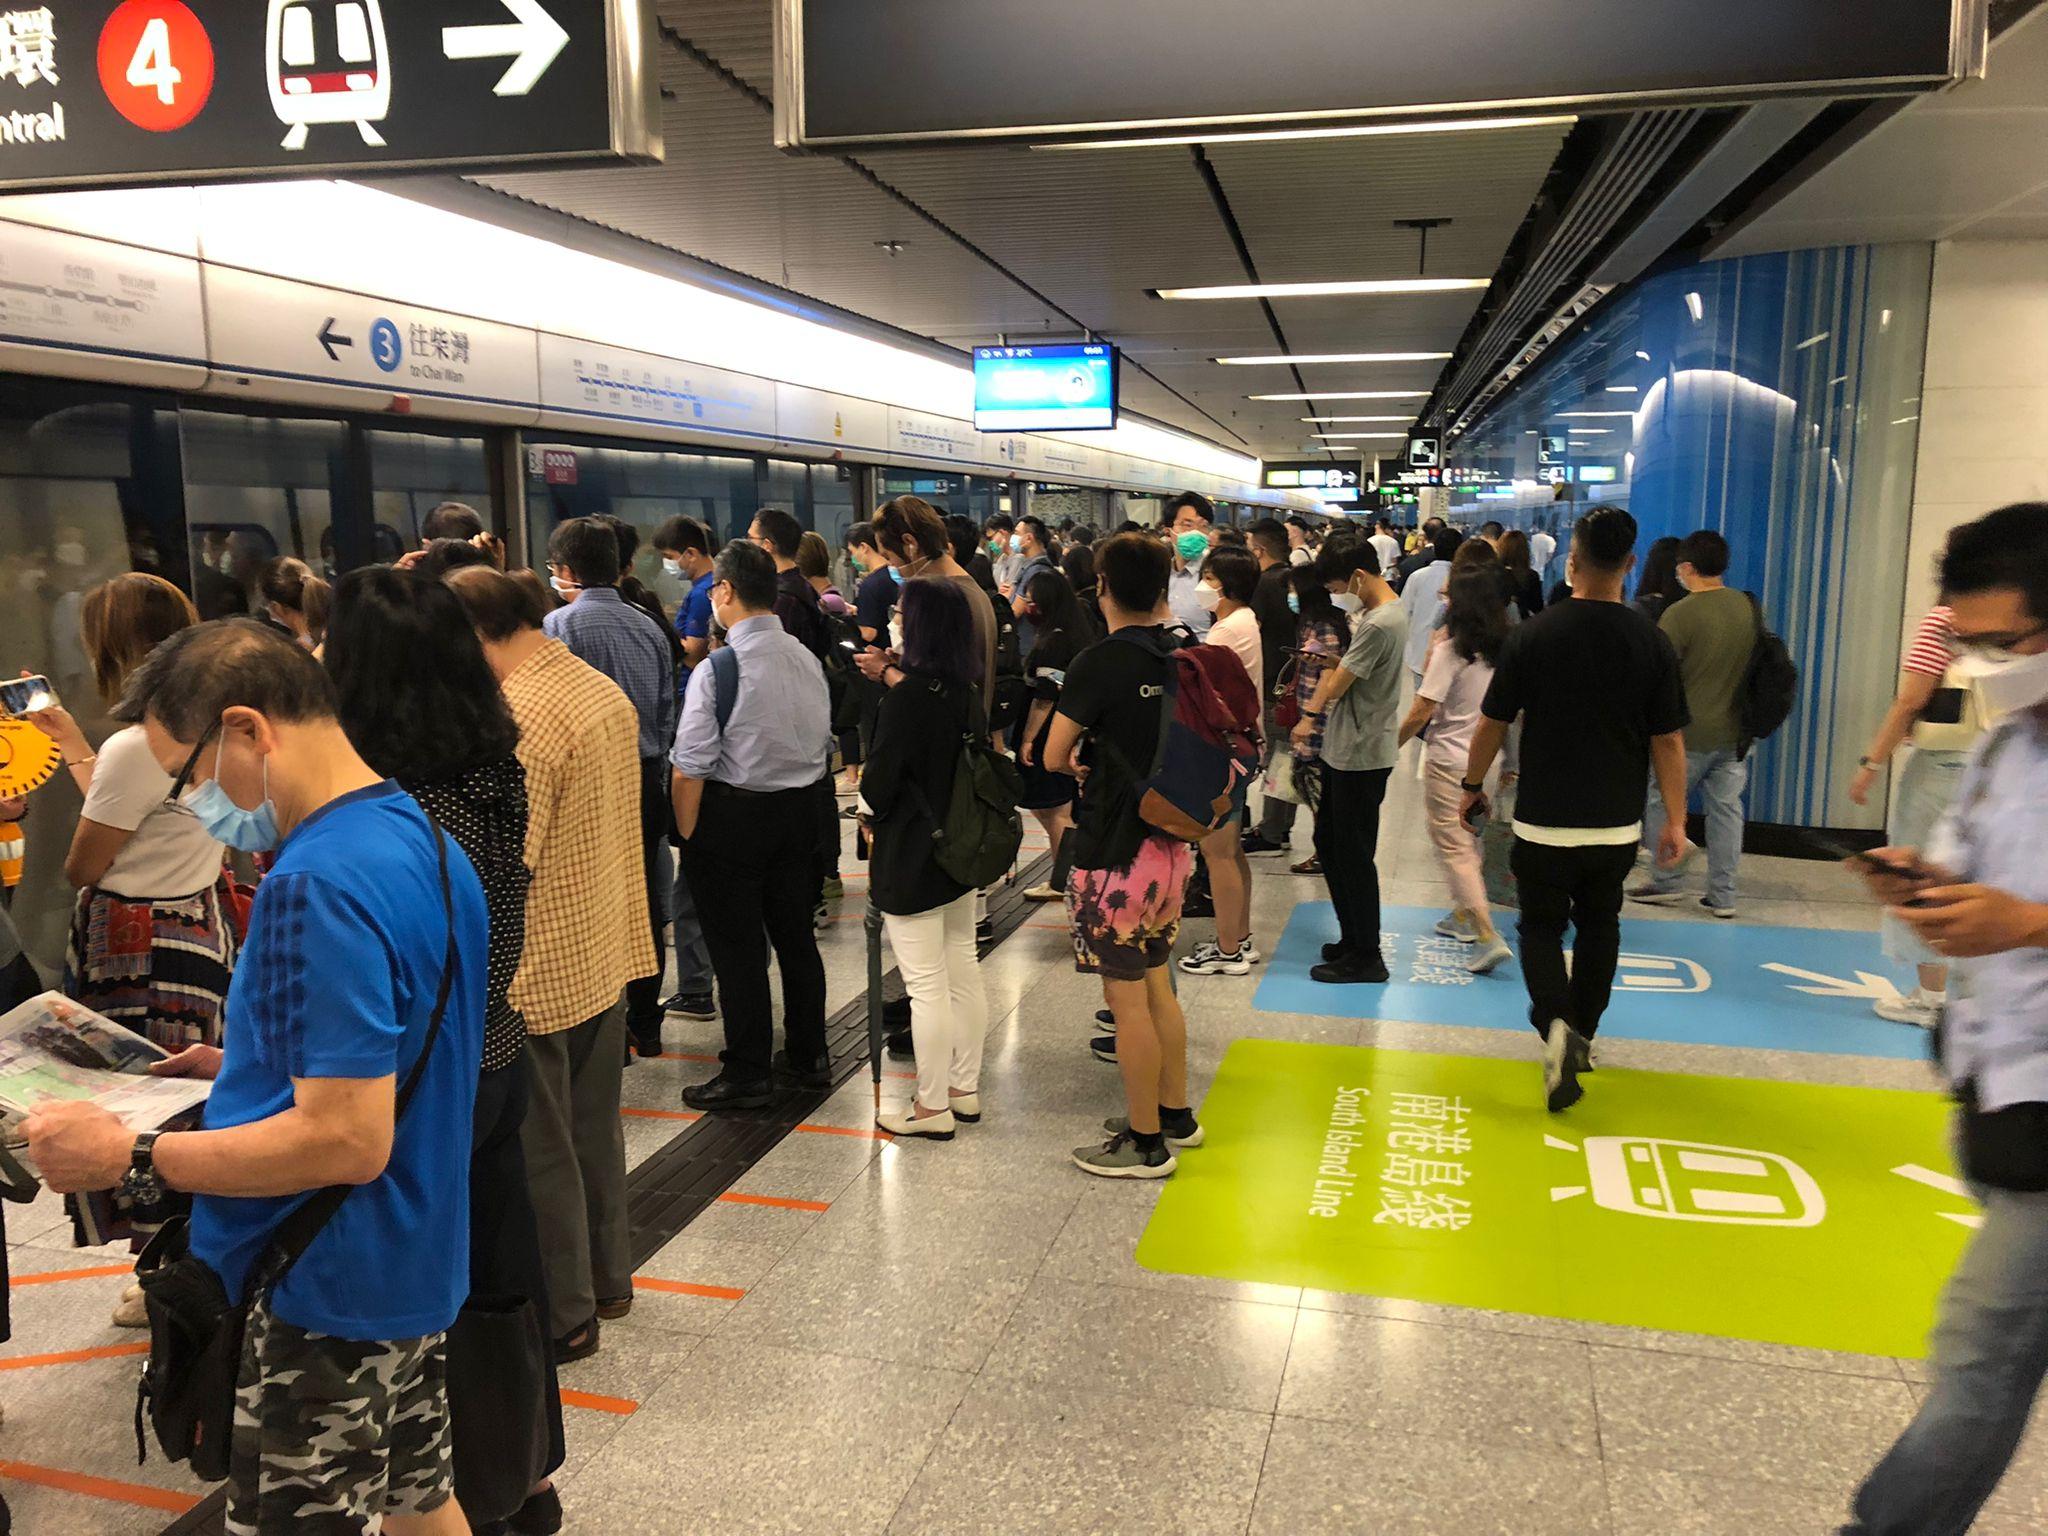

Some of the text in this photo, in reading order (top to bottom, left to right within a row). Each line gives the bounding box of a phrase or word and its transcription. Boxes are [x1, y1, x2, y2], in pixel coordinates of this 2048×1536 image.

[126, 17, 181, 105] 4
[378, 327, 395, 365] 3
[409, 322, 470, 365] 往柴灣
[409, 364, 465, 384] to Chai Wan
[1308, 1085, 1372, 1218] South Island Line
[1372, 1091, 1473, 1231] 南港島綫
